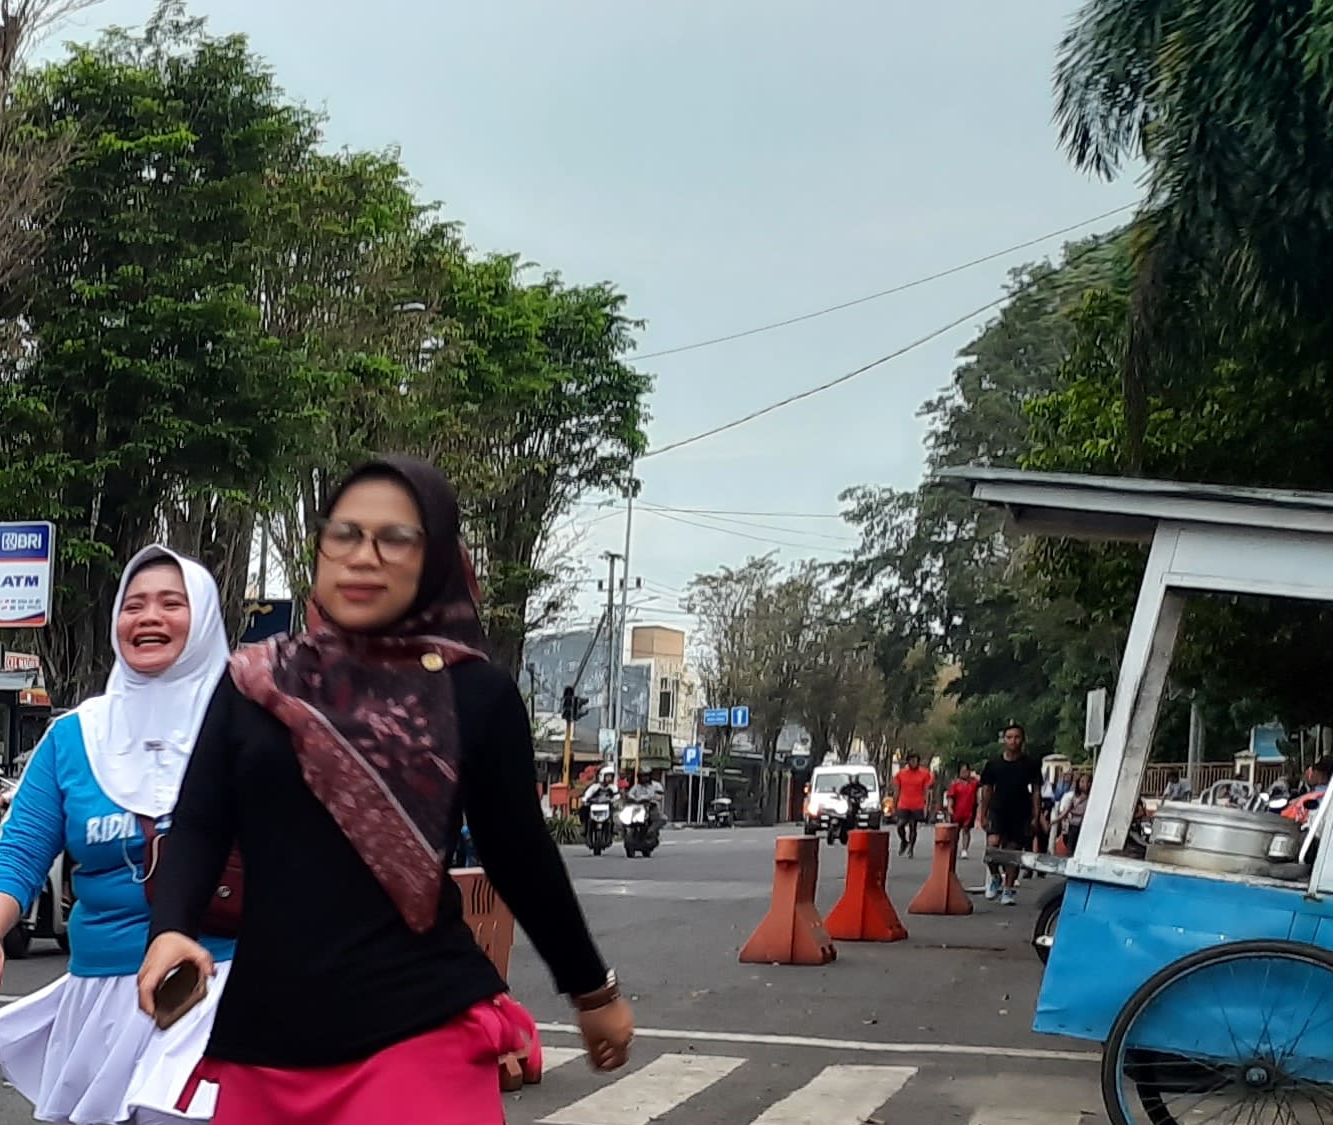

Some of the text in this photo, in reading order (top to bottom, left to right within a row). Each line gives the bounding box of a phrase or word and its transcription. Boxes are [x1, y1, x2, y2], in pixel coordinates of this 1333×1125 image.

[18, 533, 42, 549] BRI
[0, 575, 39, 588] ATM
[686, 748, 697, 763] P
